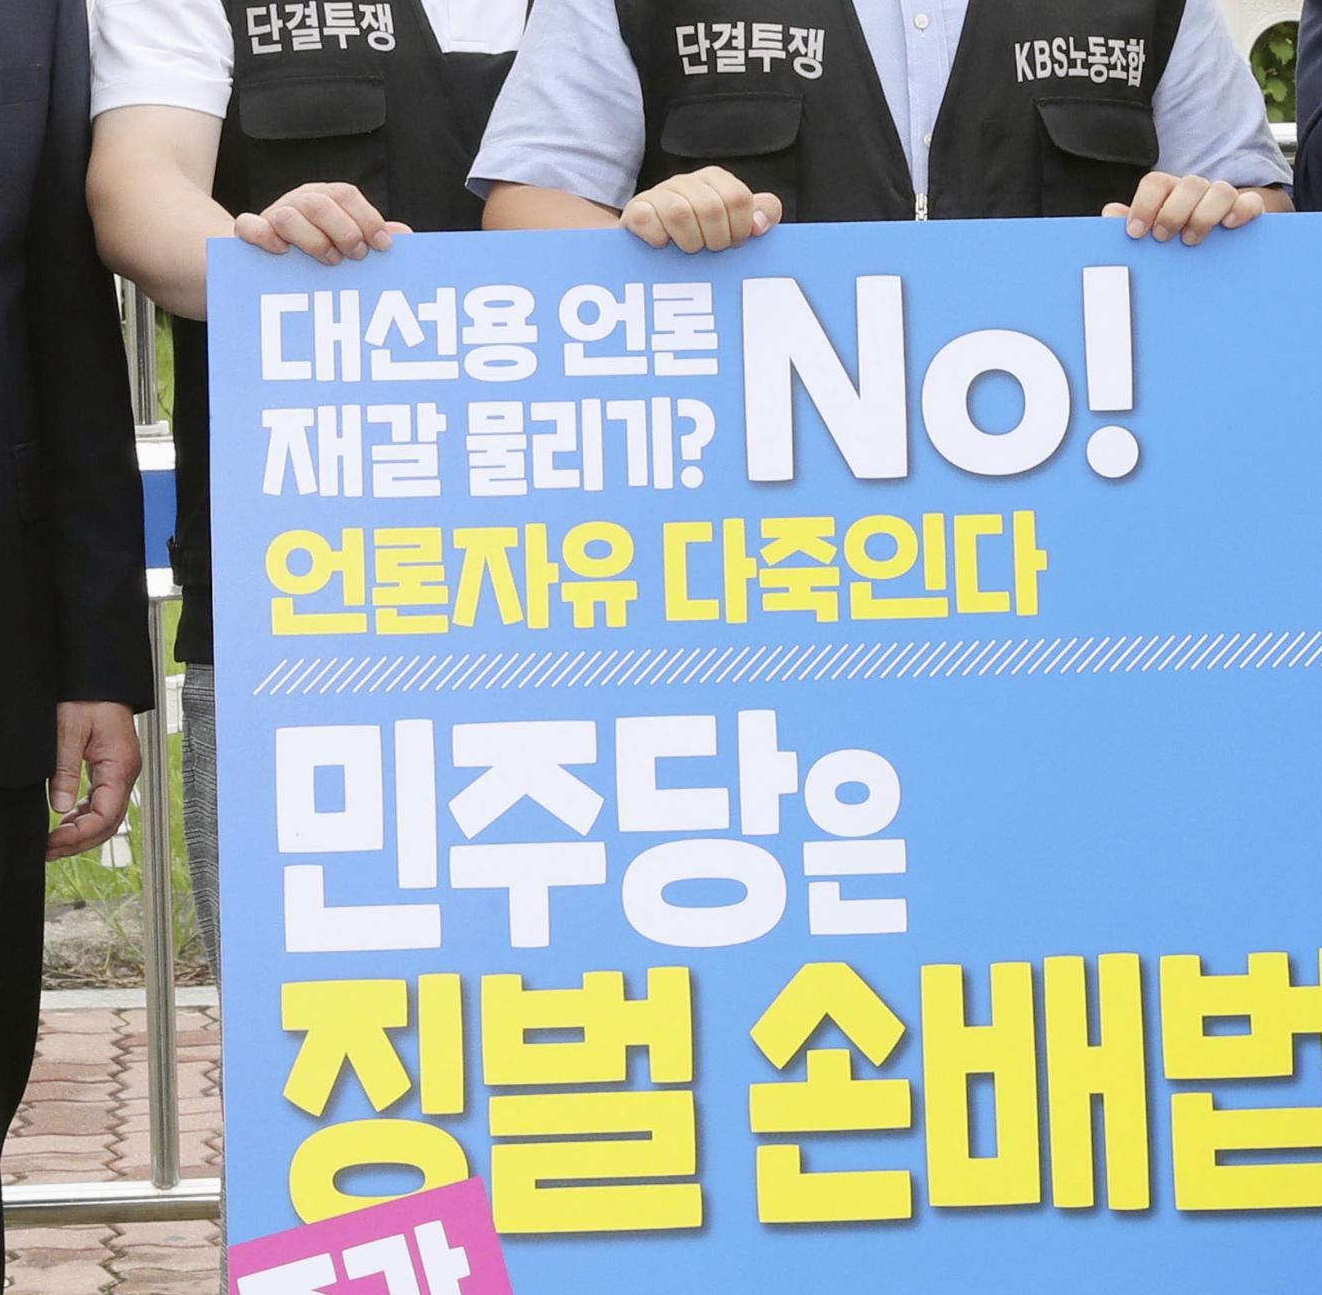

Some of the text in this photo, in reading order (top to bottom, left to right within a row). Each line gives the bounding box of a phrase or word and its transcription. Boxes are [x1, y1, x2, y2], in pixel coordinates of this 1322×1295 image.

[246, 1, 396, 54] 단결투쟁
[676, 22, 825, 80] 단결투쟁
[1014, 35, 1146, 88] KBS노동조합
[260, 282, 718, 383] 대선용 언론
[742, 266, 1140, 481] No!
[261, 396, 716, 498] 재갈 물리기?
[265, 510, 1048, 635] 언론자유 다죽인다
[276, 709, 907, 953] 민주당은
[281, 966, 703, 1234] 징벌
